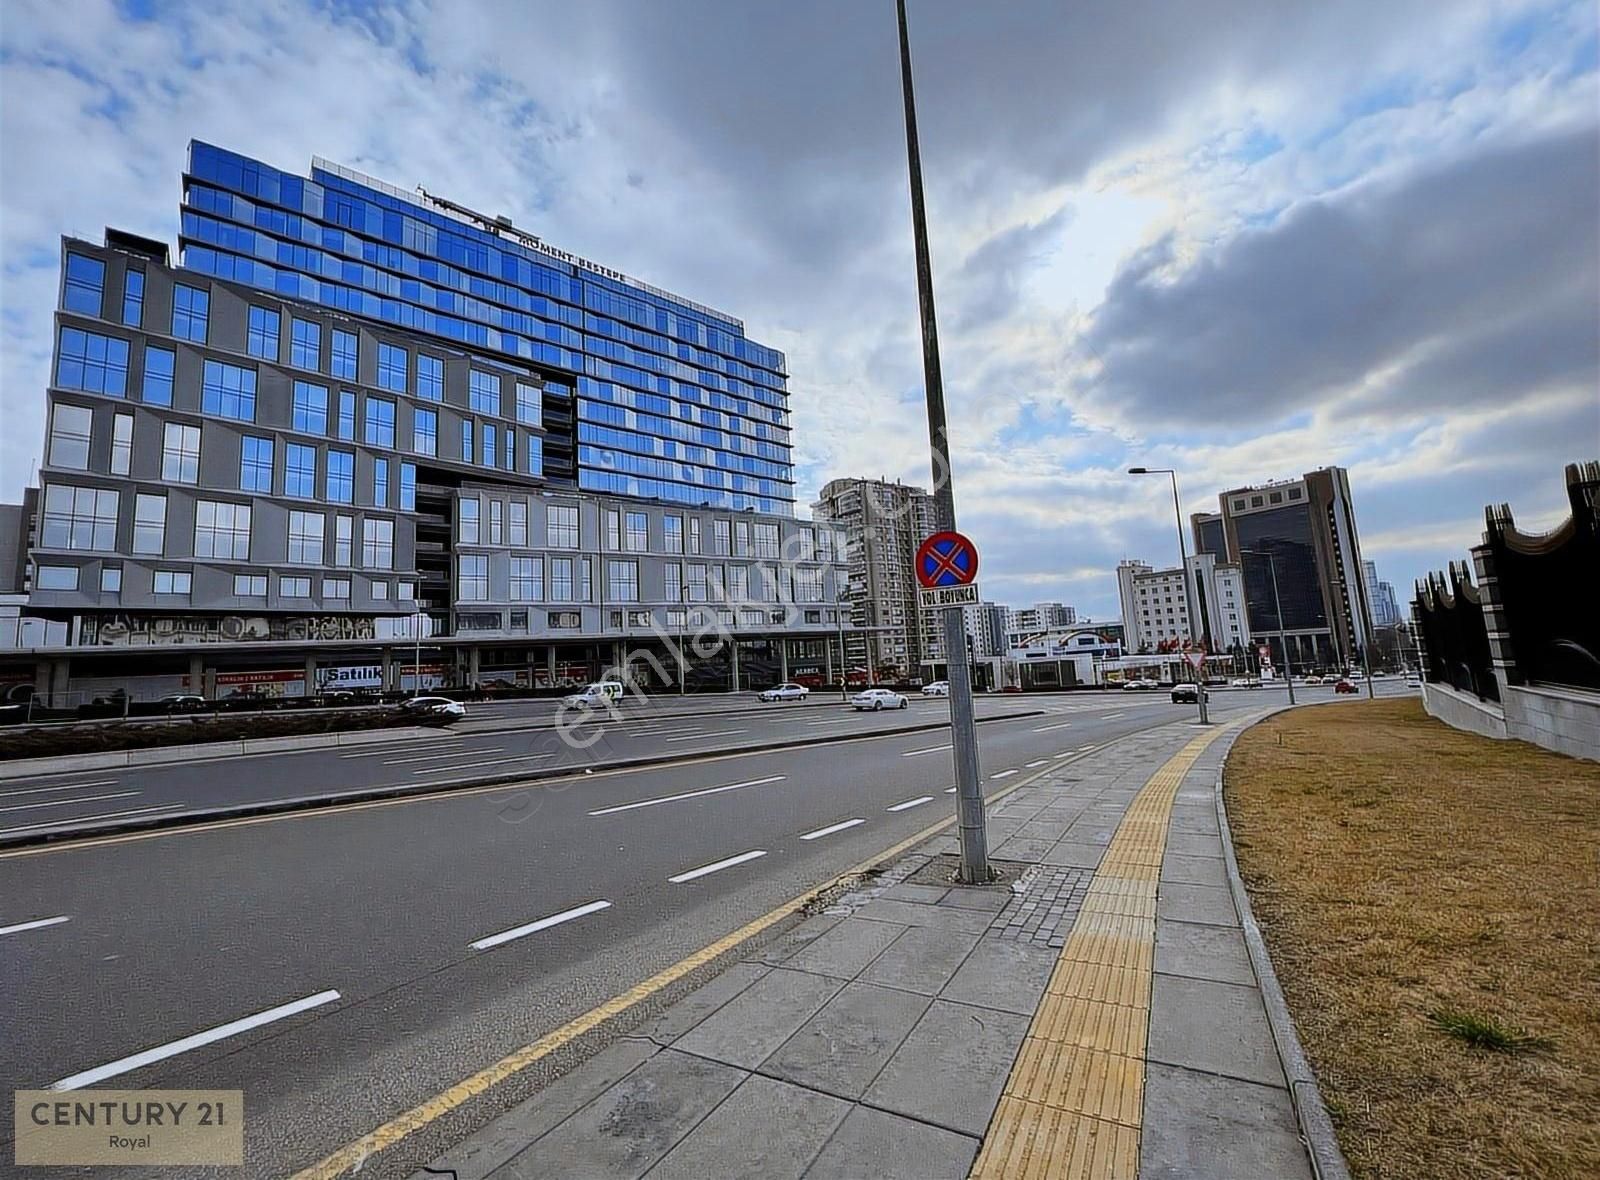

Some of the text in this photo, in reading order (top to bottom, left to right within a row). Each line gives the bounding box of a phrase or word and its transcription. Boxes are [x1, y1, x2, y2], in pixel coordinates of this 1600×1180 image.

[518, 235, 572, 262] MOMENT
[921, 587, 976, 606] YOL BOYUNCA
